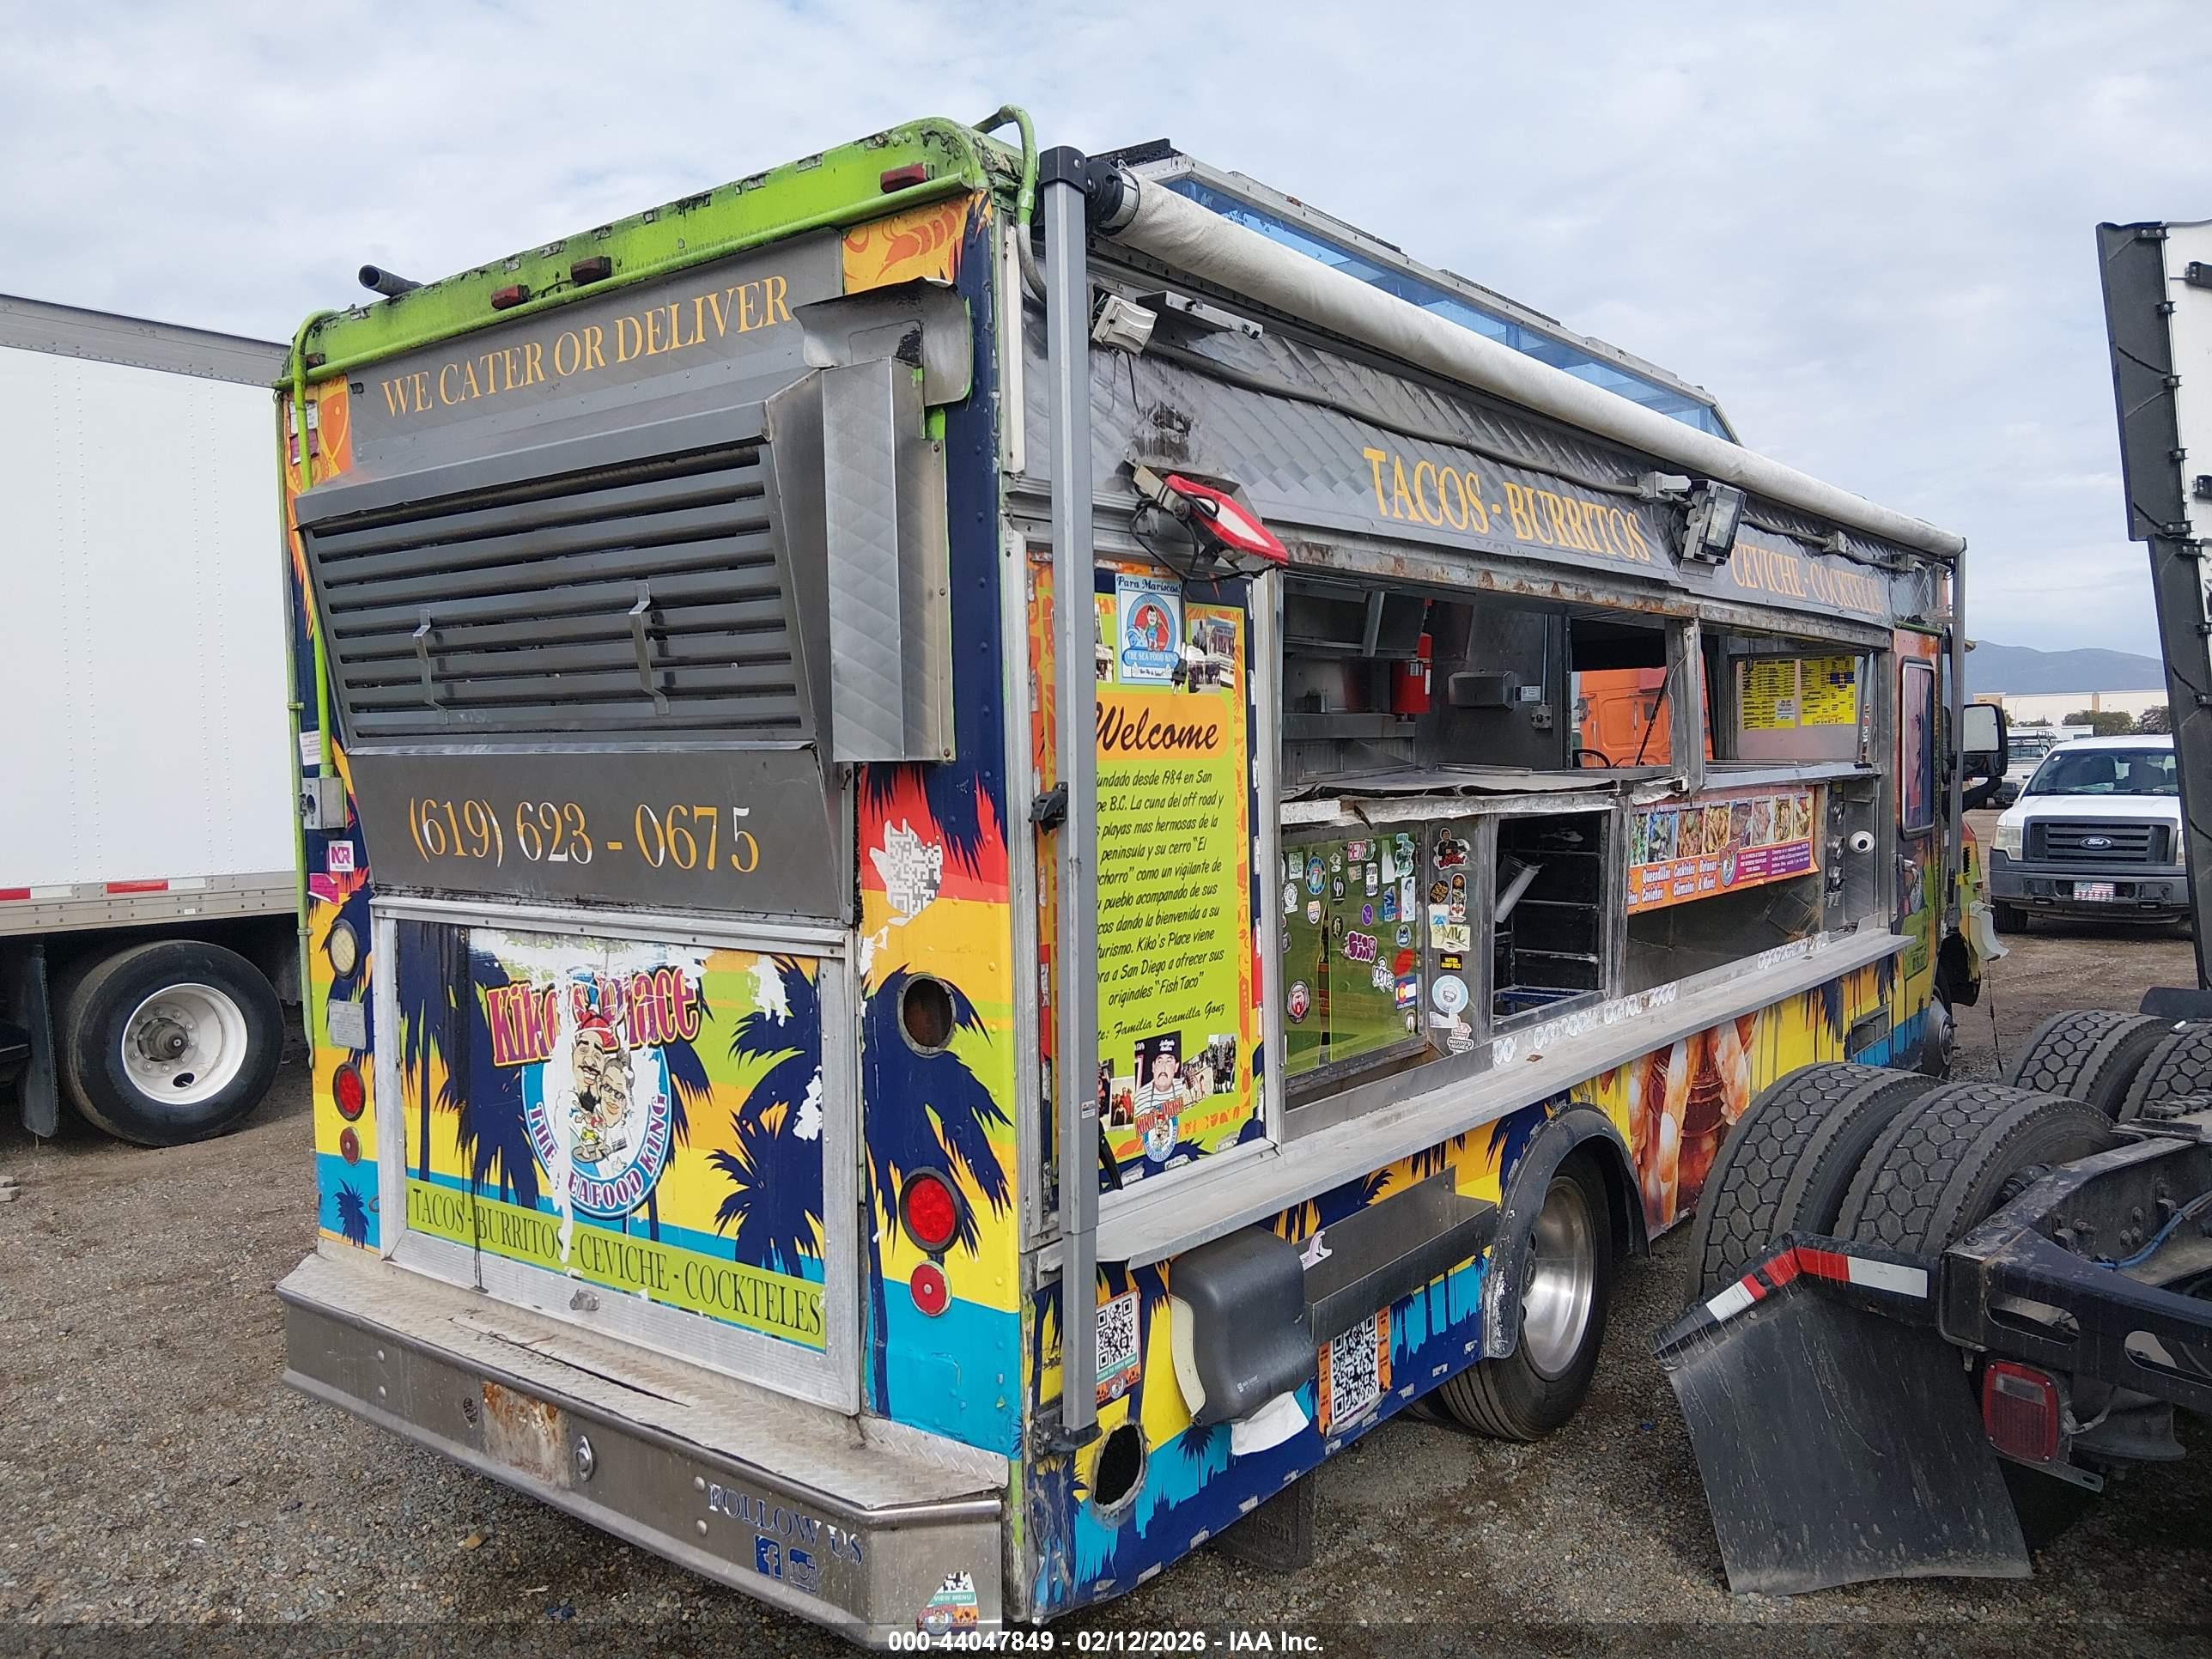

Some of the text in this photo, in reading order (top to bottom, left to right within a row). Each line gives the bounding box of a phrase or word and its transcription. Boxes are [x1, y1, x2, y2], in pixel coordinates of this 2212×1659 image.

[380, 275, 793, 418] WE CATER OR DELIVER
[1363, 447, 1490, 535] TACOS
[1504, 481, 1653, 563] BURRITOS
[1116, 575, 1182, 593] Para Mariscos!
[1730, 543, 1807, 599] CEVICHE
[1097, 702, 1219, 751] Welcome
[1097, 770, 1130, 787] undado
[1133, 770, 1160, 787] desde
[1184, 774, 1194, 784] en
[1196, 770, 1212, 784] San
[1109, 795, 1127, 811] B.C.
[1130, 795, 1142, 810] La
[1144, 798, 1165, 809] cuna
[1168, 792, 1181, 808] del
[1182, 792, 1197, 807] off
[1199, 790, 1218, 805] road
[1218, 793, 1224, 808] y
[409, 796, 503, 868] (619)
[516, 801, 592, 865] 623
[635, 804, 760, 873] 0675
[1101, 812, 1218, 841] playas mas hermosas de la
[2087, 837, 2106, 846] Ford
[1100, 844, 1145, 866] peninsula
[1147, 846, 1154, 860] y
[1155, 843, 1165, 855] su
[1169, 842, 1191, 854] cerro
[1136, 866, 1159, 880] como
[1162, 866, 1172, 878] un
[1175, 859, 1209, 881] vigilante
[1212, 856, 1222, 872] de
[1642, 864, 1671, 885] Quesadillas
[1103, 890, 1133, 915] pueblo
[1136, 884, 1188, 908] acompanado
[1190, 882, 1200, 897] de
[1201, 884, 1218, 896] sus
[1116, 914, 1143, 933] dando
[1146, 912, 1153, 927] la
[1155, 905, 1200, 927] bienvenida
[1202, 908, 1208, 919] a
[1209, 906, 1220, 918] su
[1136, 933, 1165, 955] Kiko's
[1168, 930, 1191, 948] Place
[1193, 928, 1215, 942] viene
[1112, 969, 1119, 981] a
[1121, 961, 1139, 980] San
[1140, 957, 1166, 976] Diego
[1168, 959, 1174, 970] a
[1176, 952, 1207, 969] ofrecer
[1208, 949, 1224, 962] sus
[1108, 986, 1153, 1008] originales
[1114, 1018, 1152, 1038] Familia
[1156, 1006, 1200, 1028] Escamilla
[639, 1093, 669, 1175] KING
[568, 1173, 643, 1211] EAFOOD
[413, 1188, 464, 1233] TACOS
[579, 1233, 670, 1292] CEVICHE
[685, 1260, 823, 1337] COCKTELES
[708, 1482, 864, 1565] FOLLOW US
